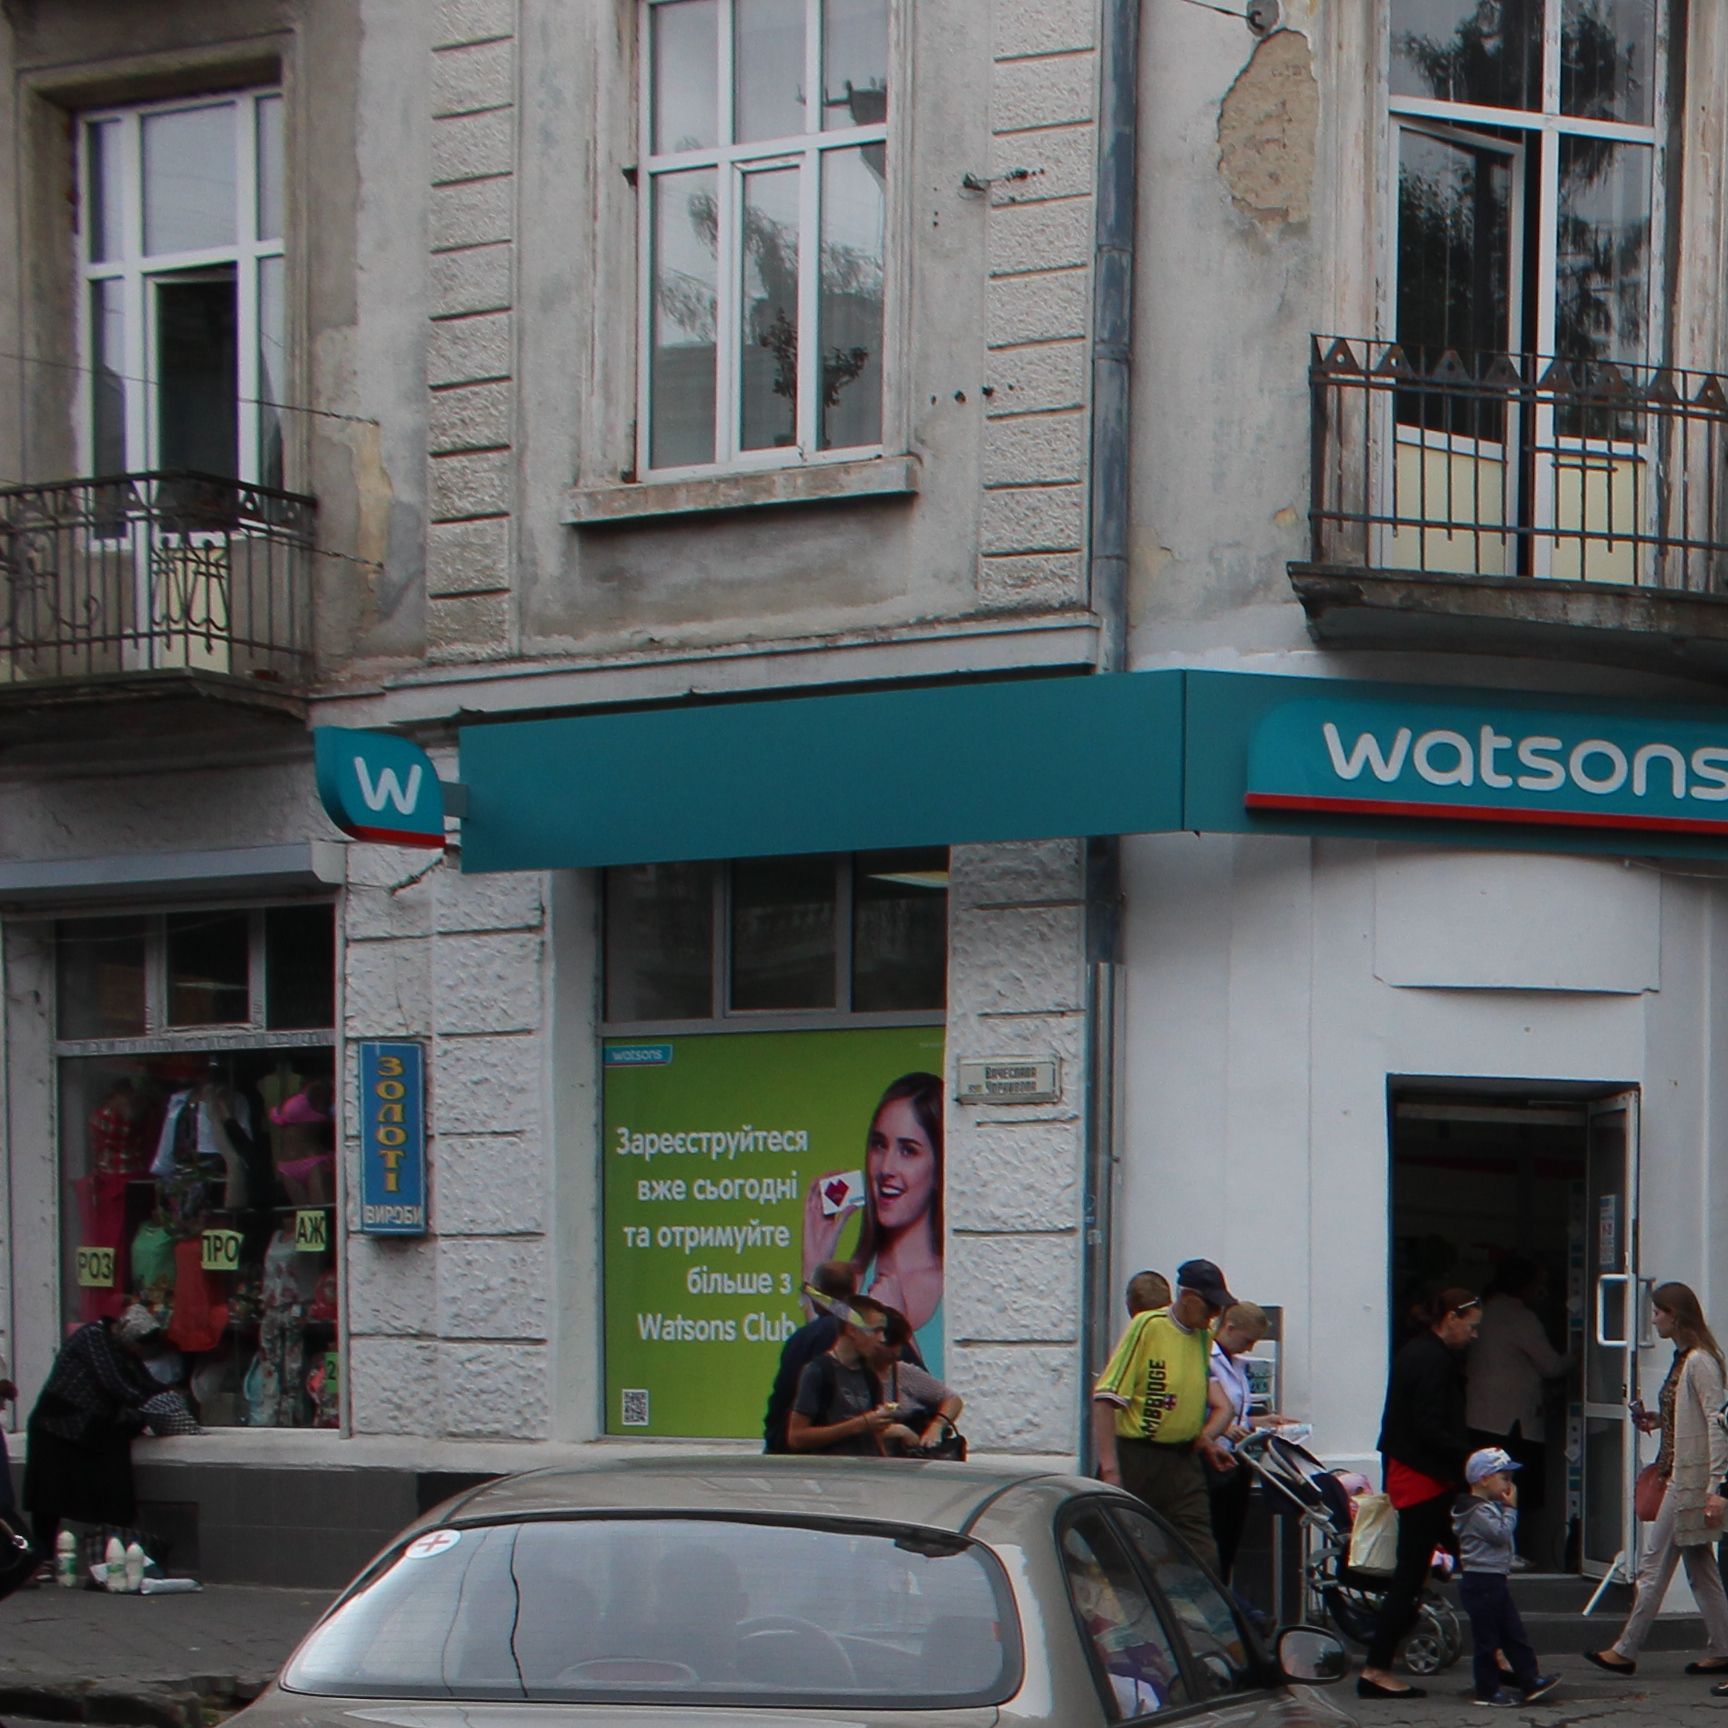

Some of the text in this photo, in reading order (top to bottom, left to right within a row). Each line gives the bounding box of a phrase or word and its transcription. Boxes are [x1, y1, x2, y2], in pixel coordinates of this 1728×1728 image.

[611, 1048, 663, 1061] watsons
[376, 1055, 407, 1192] ЗОЛОТІ
[615, 1124, 809, 1161] Зареєструйтеся
[637, 1170, 798, 1205] вже сьогодні
[364, 1204, 422, 1225] ВИРОБИ
[78, 1215, 326, 1279] РОЗ ПРО АЖ
[623, 1219, 790, 1255] та отримуйте
[686, 1266, 793, 1295] більше з
[637, 1312, 796, 1342] Watsons Club
